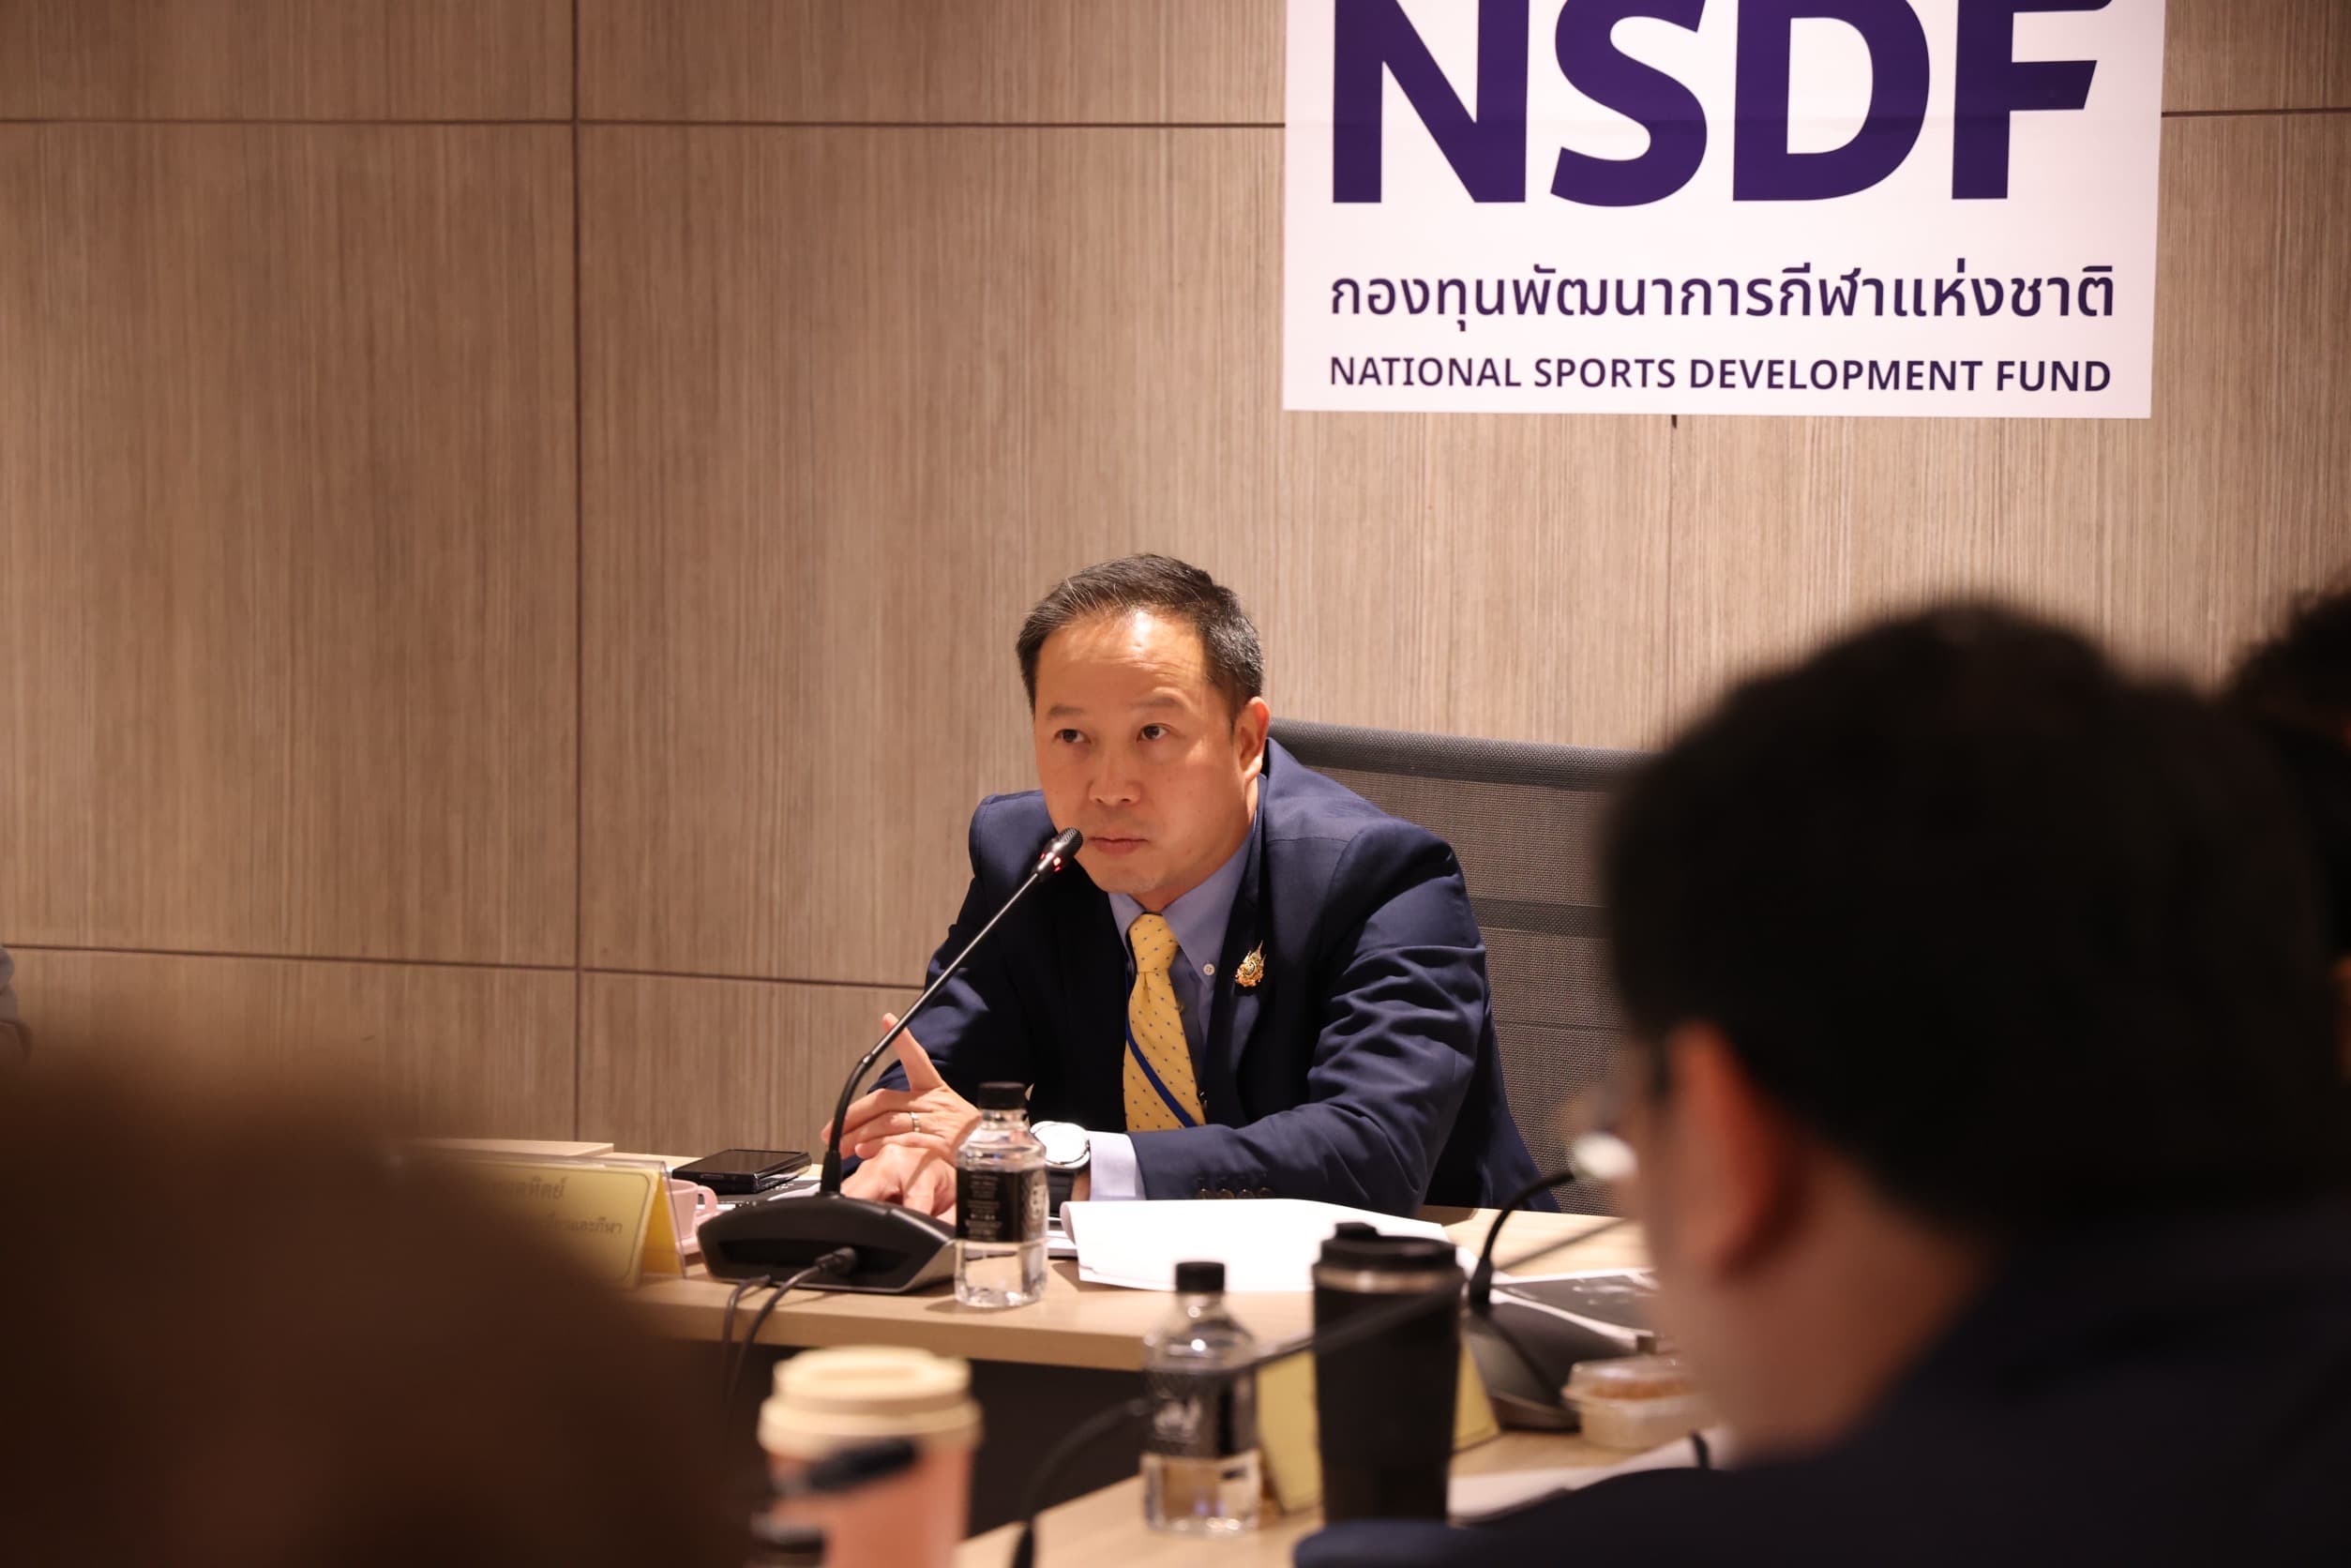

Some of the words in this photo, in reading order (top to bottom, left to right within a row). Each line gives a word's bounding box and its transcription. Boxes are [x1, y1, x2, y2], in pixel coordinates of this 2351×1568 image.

[1334, 0, 2112, 207] NSDF
[1332, 258, 2114, 332] กองทุนพัฒนาการกีฬาแห่งชาติ
[1331, 356, 1522, 387] NATIONAL
[1534, 357, 1676, 388] SPORTS
[1690, 358, 1983, 391] DEVELOPMENT
[1997, 360, 2111, 392] FUND
